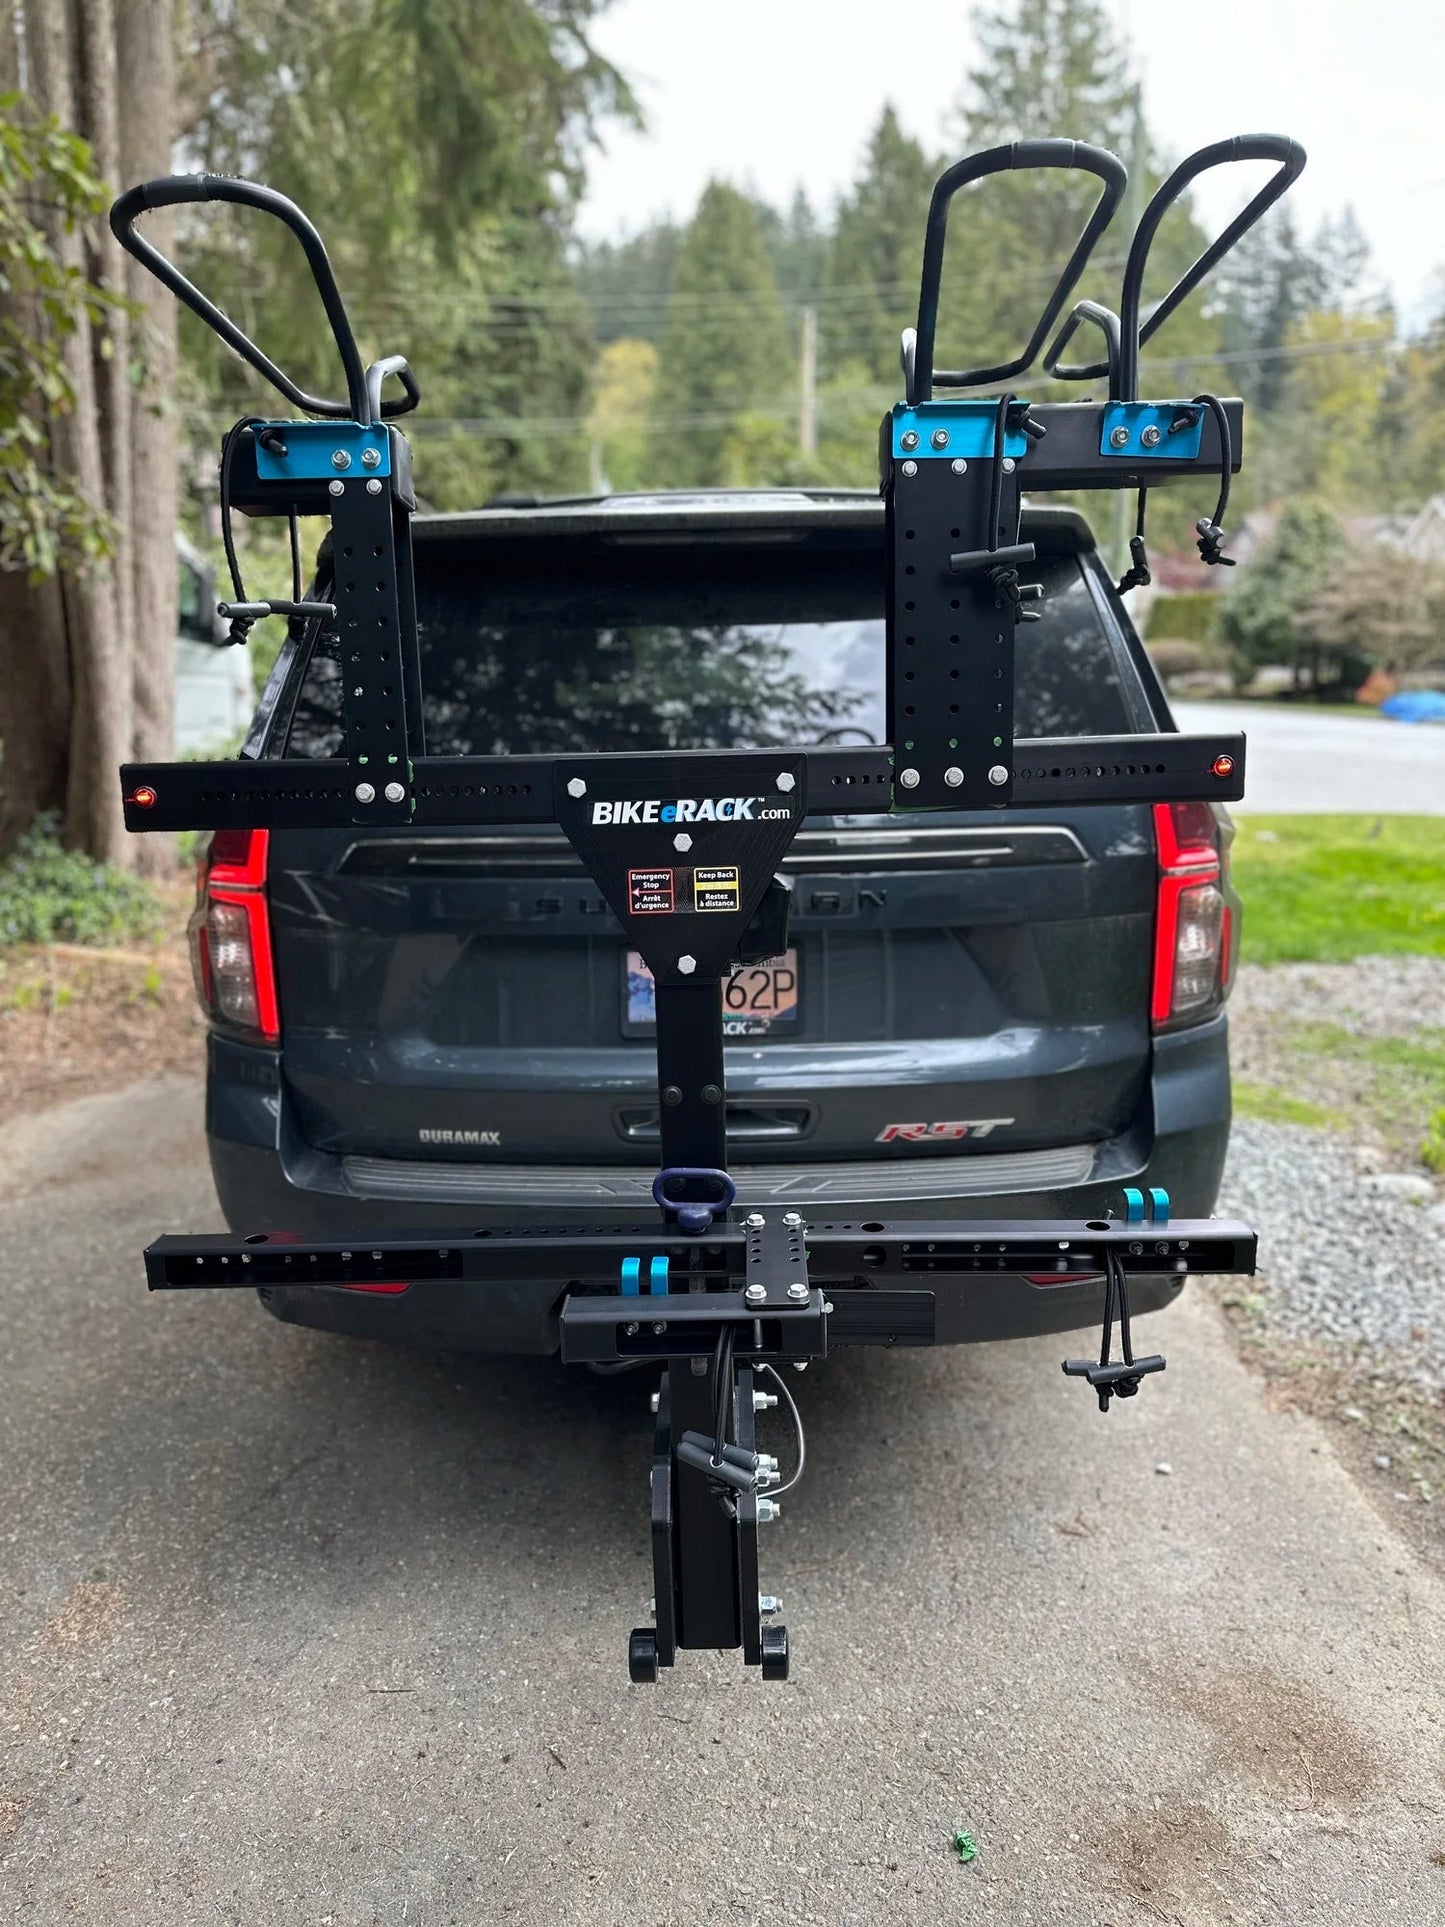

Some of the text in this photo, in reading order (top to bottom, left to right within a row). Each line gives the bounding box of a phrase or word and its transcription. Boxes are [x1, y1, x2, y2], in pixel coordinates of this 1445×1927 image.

[631, 873, 671, 882] Emergency
[698, 872, 715, 880] Keep
[643, 881, 660, 889] Stop
[643, 894, 661, 902] Arrêt
[634, 901, 670, 910] d'urgence
[699, 899, 734, 907] à distance
[874, 1117, 1016, 1143] RST
[419, 1128, 501, 1146] DURAMAX
